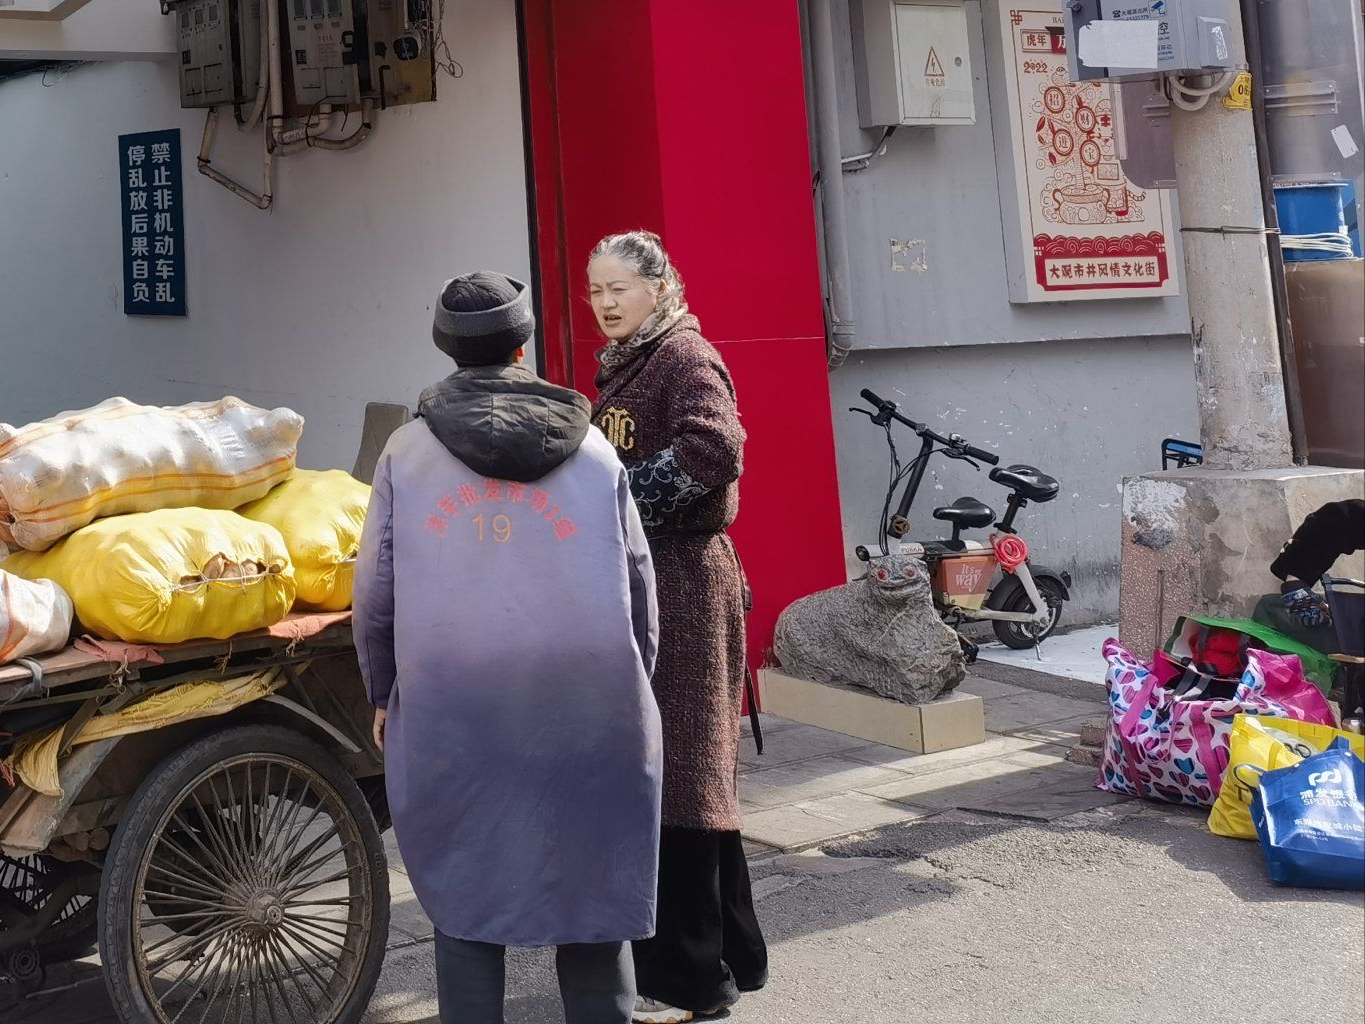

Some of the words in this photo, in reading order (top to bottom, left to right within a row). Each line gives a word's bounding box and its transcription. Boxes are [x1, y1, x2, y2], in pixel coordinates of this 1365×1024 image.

[127, 145, 150, 303] 停乱放后果自负
[151, 142, 176, 303] 禁止非机动车乱
[1049, 260, 1156, 280] 大观市井风情文化街
[472, 513, 512, 543] 19
